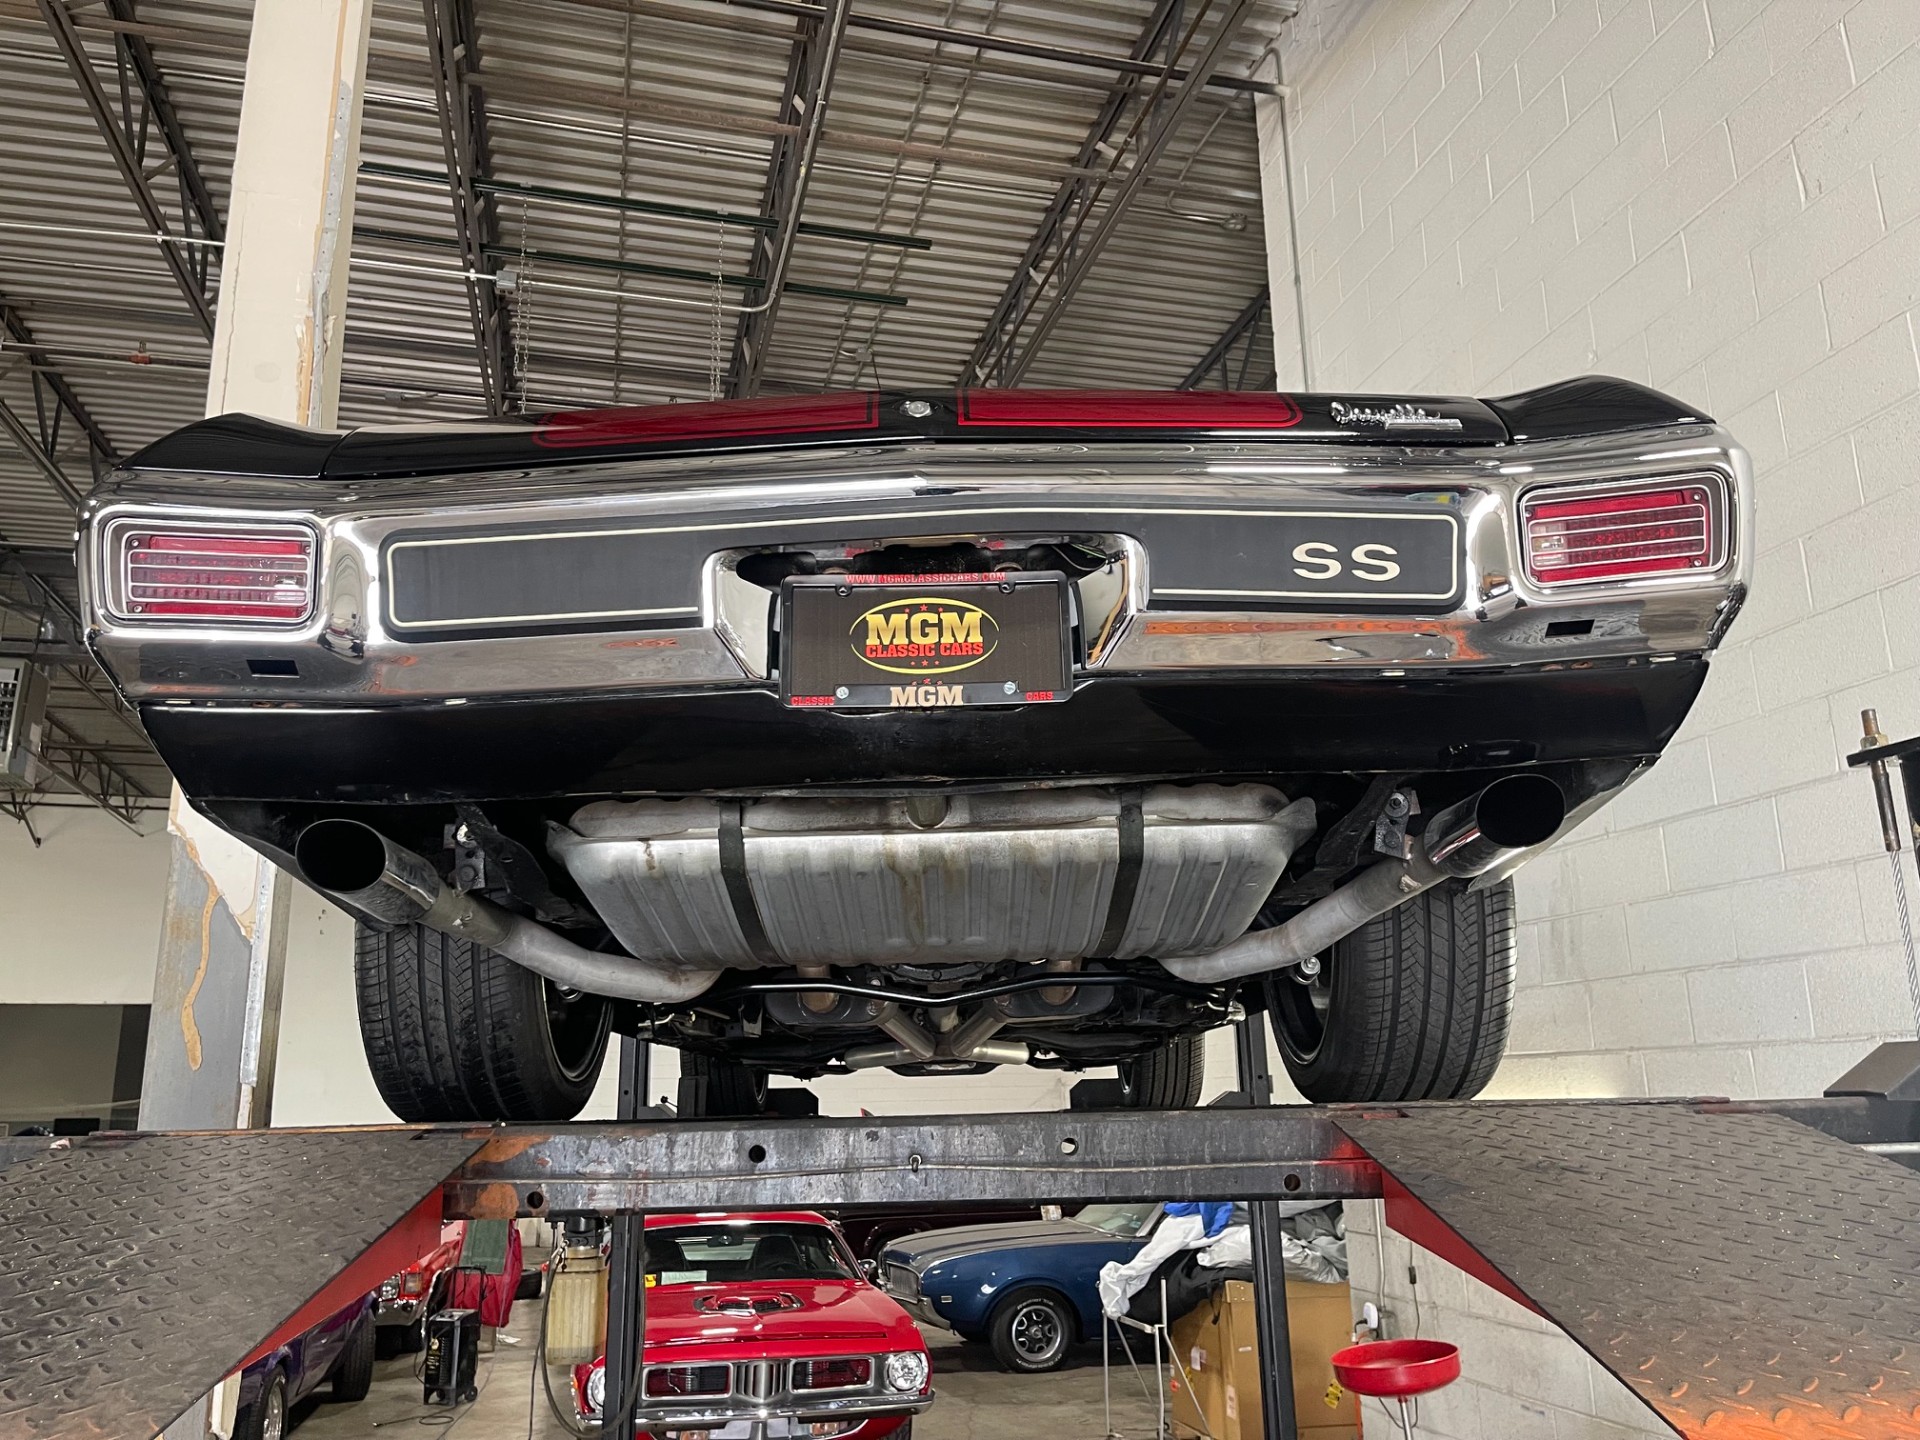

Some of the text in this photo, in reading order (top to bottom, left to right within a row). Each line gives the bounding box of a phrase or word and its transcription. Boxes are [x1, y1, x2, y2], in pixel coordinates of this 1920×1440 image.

[1292, 542, 1400, 581] SS
[866, 612, 983, 645] MGM
[866, 641, 984, 658] CLASSIC CARS
[791, 696, 835, 706] CLASSIC
[890, 685, 964, 707] MGM
[1026, 691, 1053, 701] CARS
